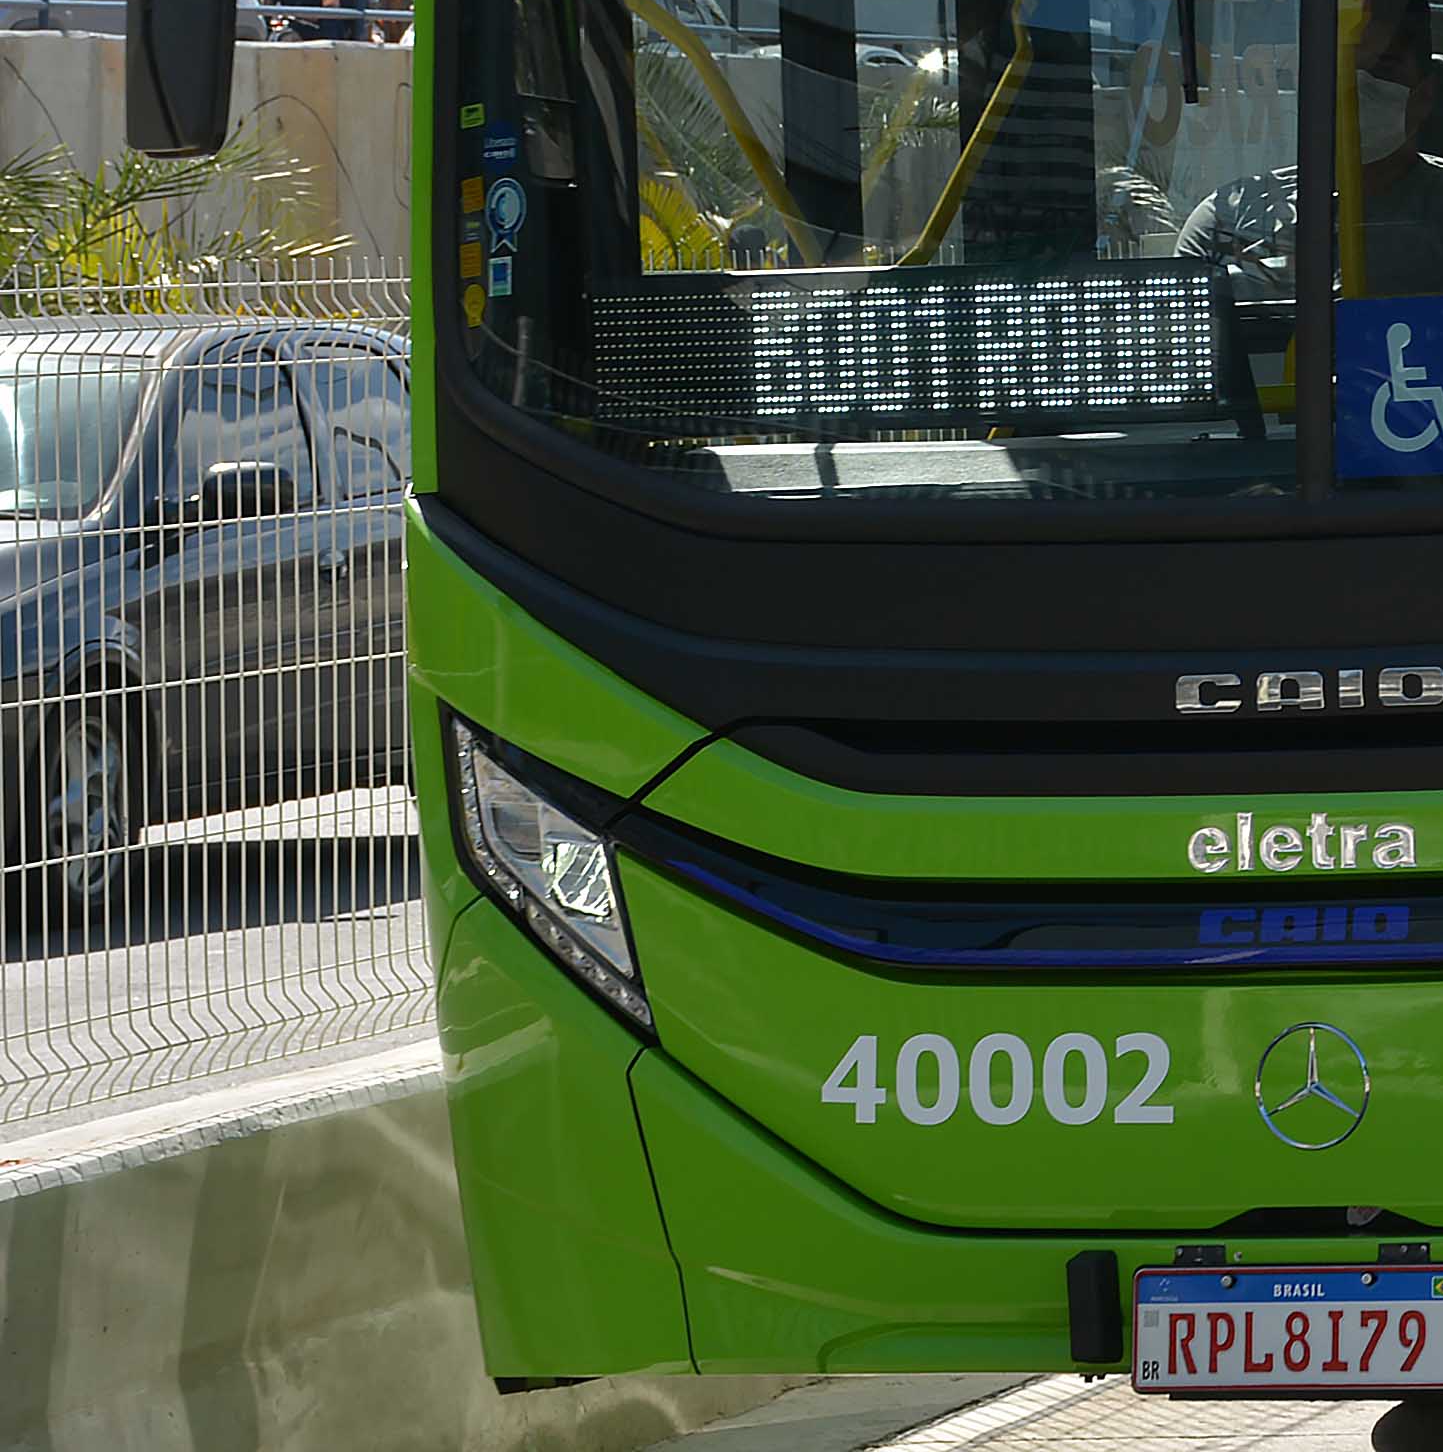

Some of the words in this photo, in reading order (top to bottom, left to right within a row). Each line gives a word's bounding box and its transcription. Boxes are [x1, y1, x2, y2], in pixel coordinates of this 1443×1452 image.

[751, 284, 950, 414] B001
[1187, 812, 1417, 871] eletra
[1200, 905, 1410, 945] CAIO
[820, 1032, 1176, 1125] 40002
[1272, 1283, 1326, 1298] BRASIL
[1142, 1360, 1160, 1381] BR
[1167, 1310, 1427, 1375] RPL8I79
